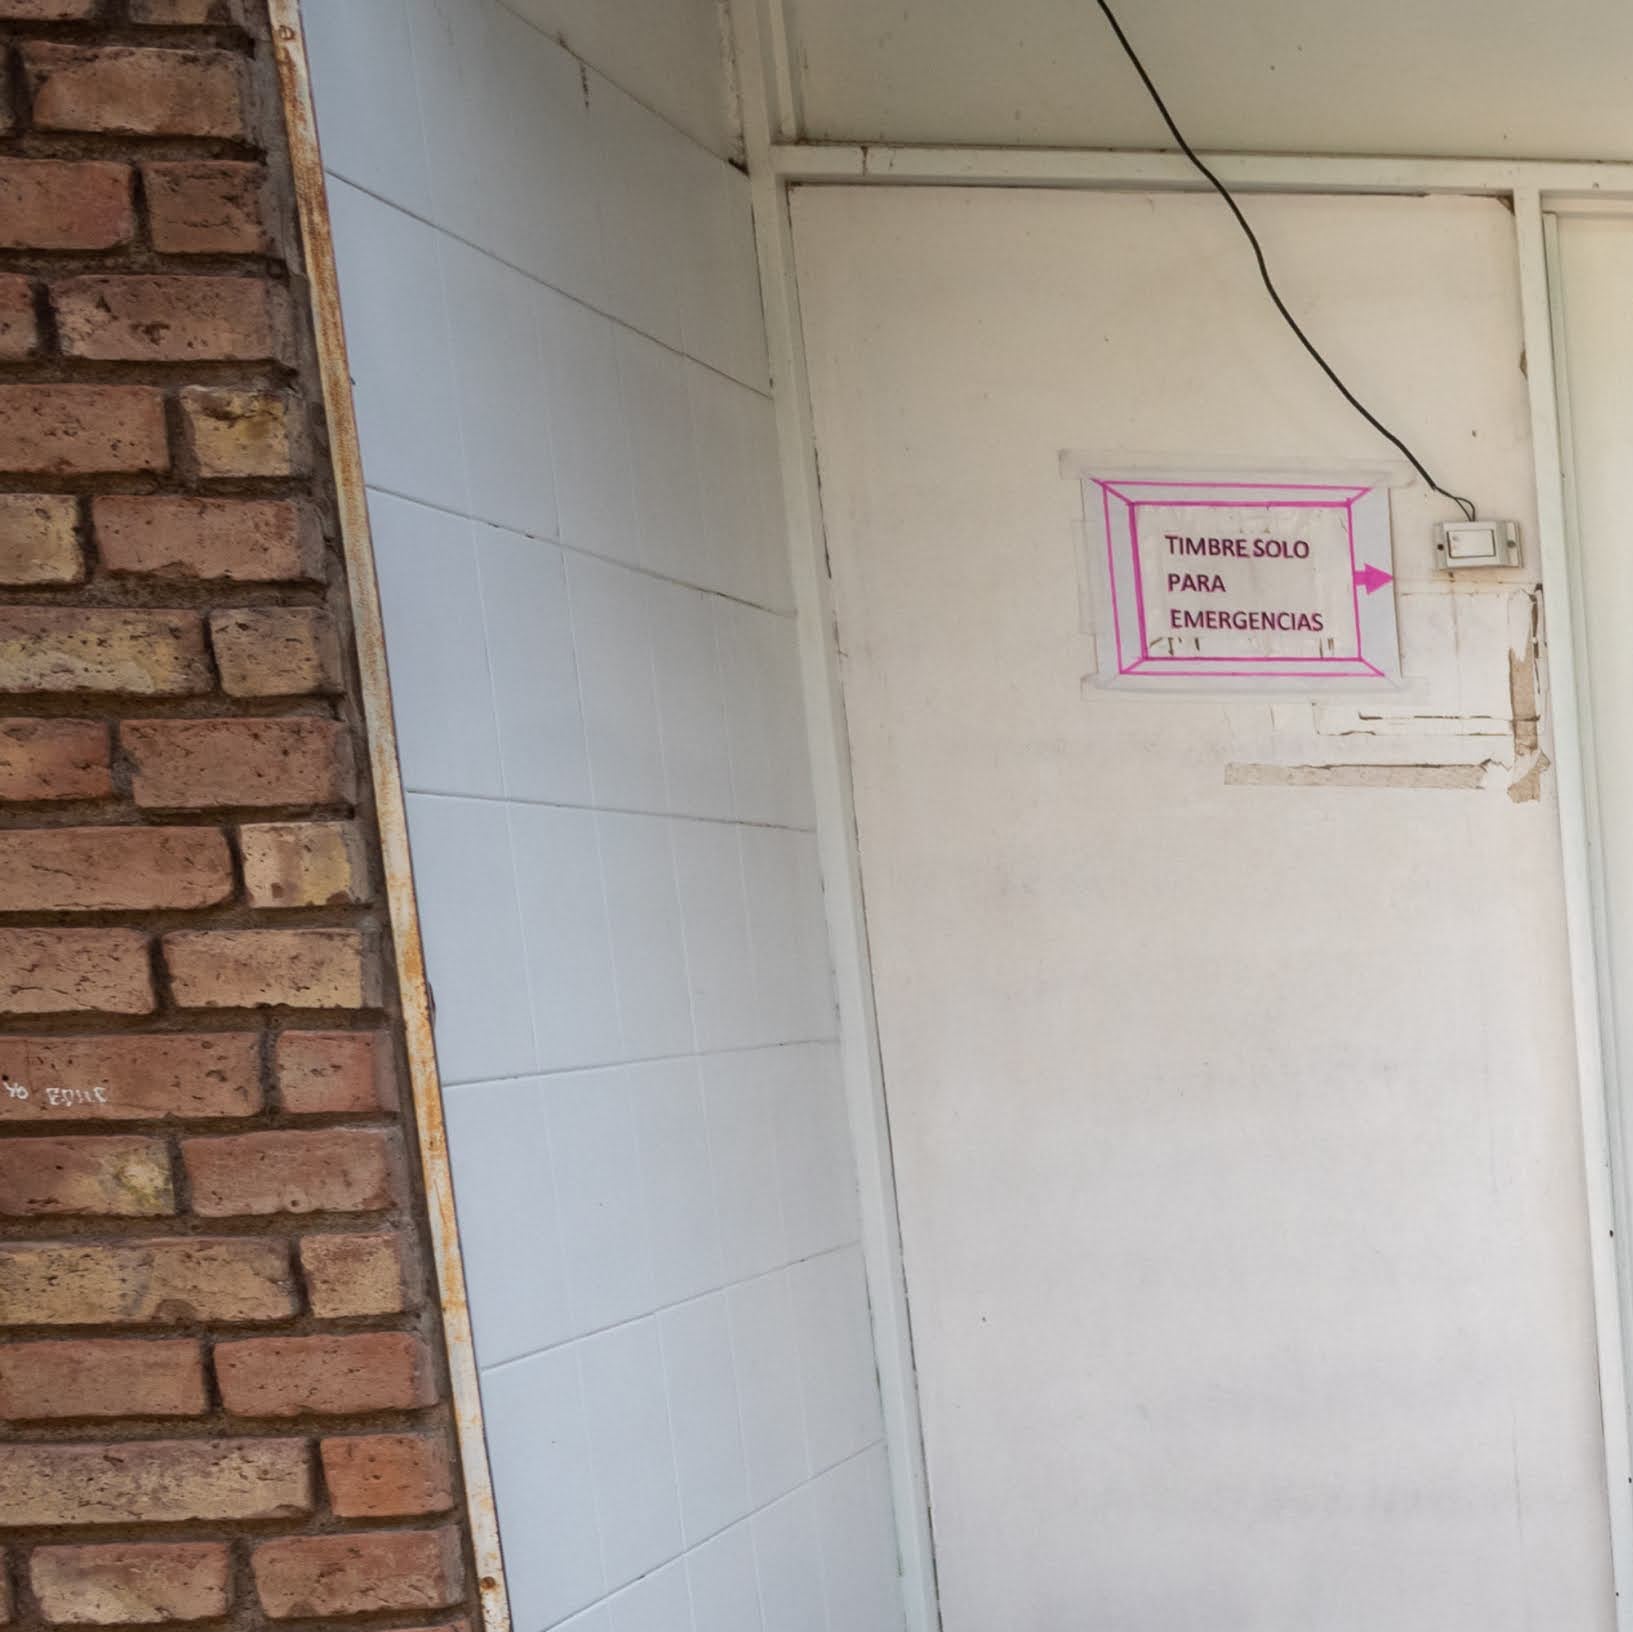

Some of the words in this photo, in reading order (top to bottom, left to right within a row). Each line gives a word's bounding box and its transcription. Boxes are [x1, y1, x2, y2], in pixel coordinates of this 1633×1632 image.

[1164, 534, 1249, 558] TIMBRE
[1253, 538, 1310, 559] SOLO
[1168, 572, 1226, 592] PARA
[1170, 608, 1324, 632] EMERGENCIAS
